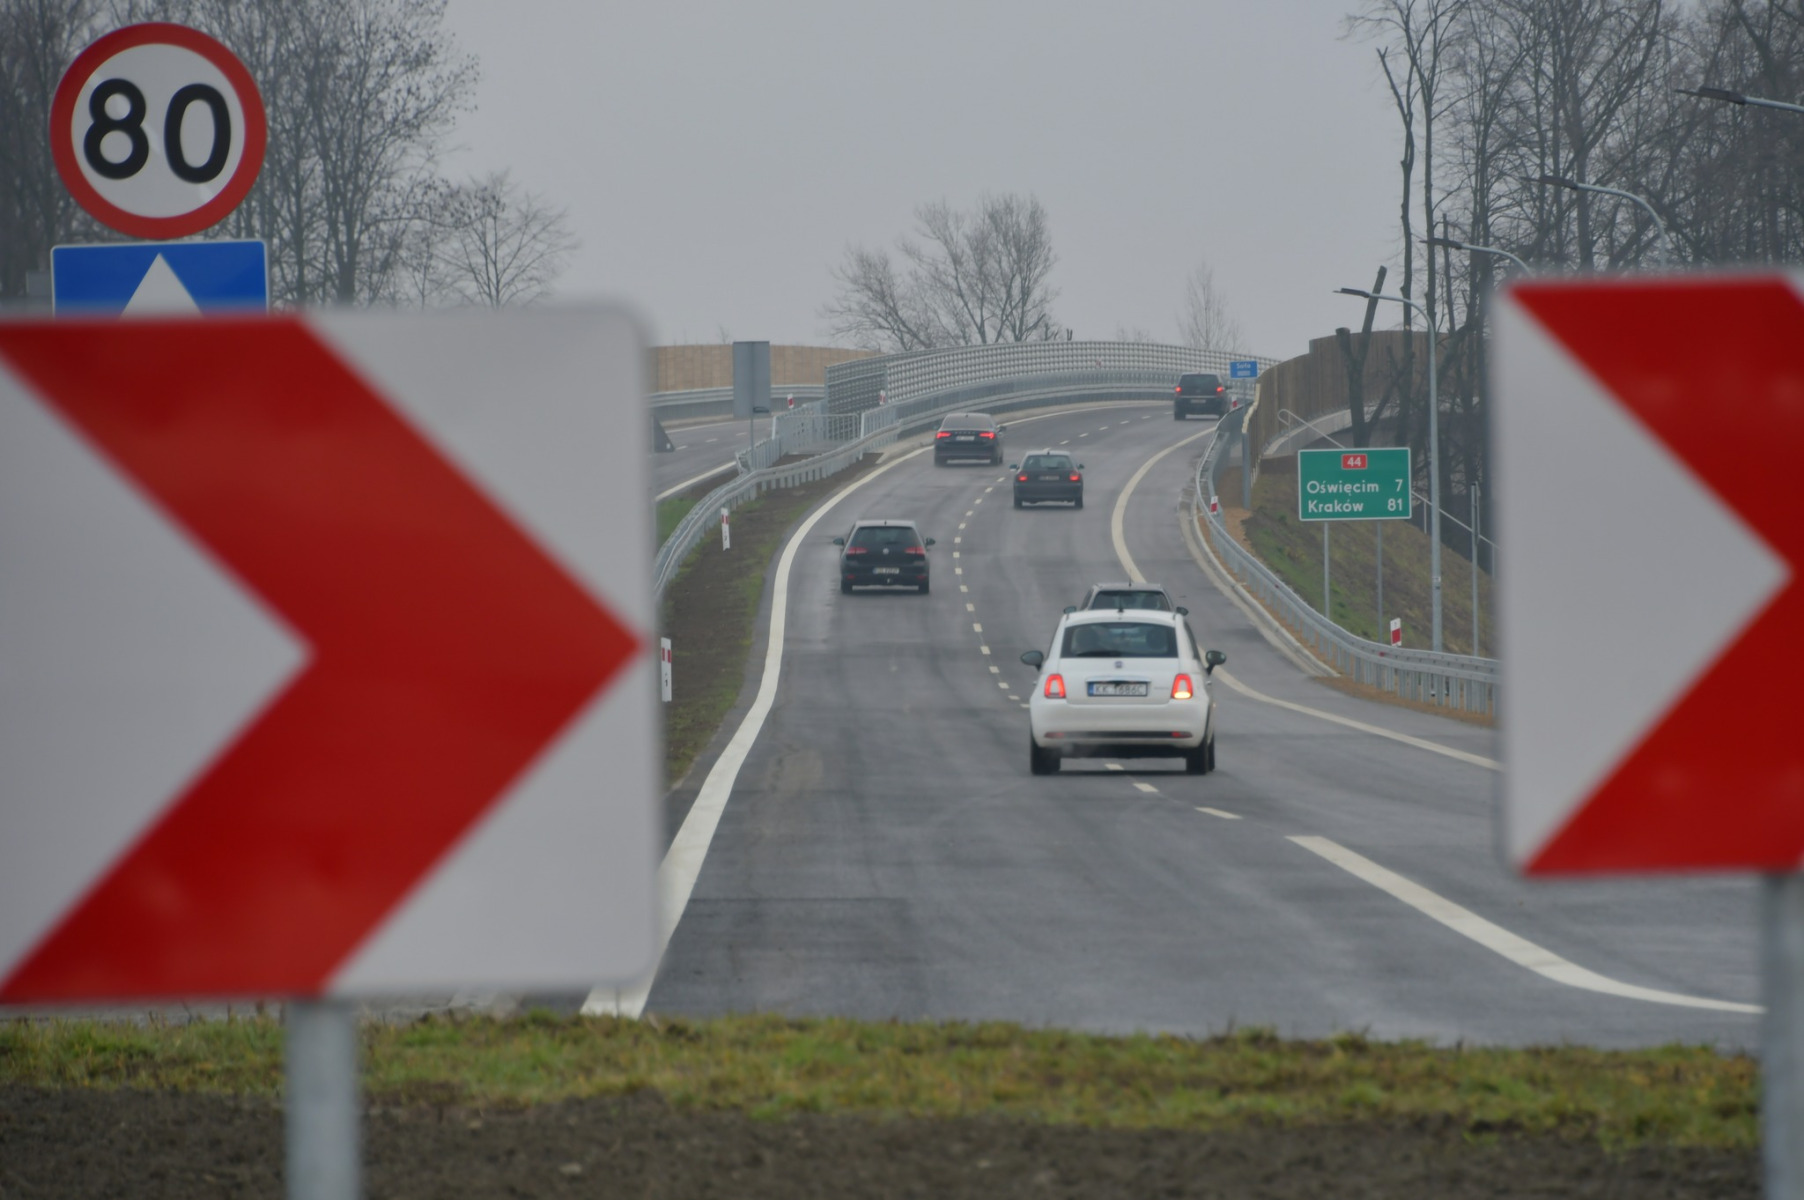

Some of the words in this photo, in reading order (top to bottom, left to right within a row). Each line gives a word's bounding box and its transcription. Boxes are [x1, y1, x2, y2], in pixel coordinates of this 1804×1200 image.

[83, 77, 231, 184] 80
[1347, 456, 1361, 467] 44
[1307, 480, 1379, 496] Oświęcim
[1395, 479, 1403, 492] 7
[1308, 499, 1364, 513] Kraków
[1387, 498, 1403, 511] 81
